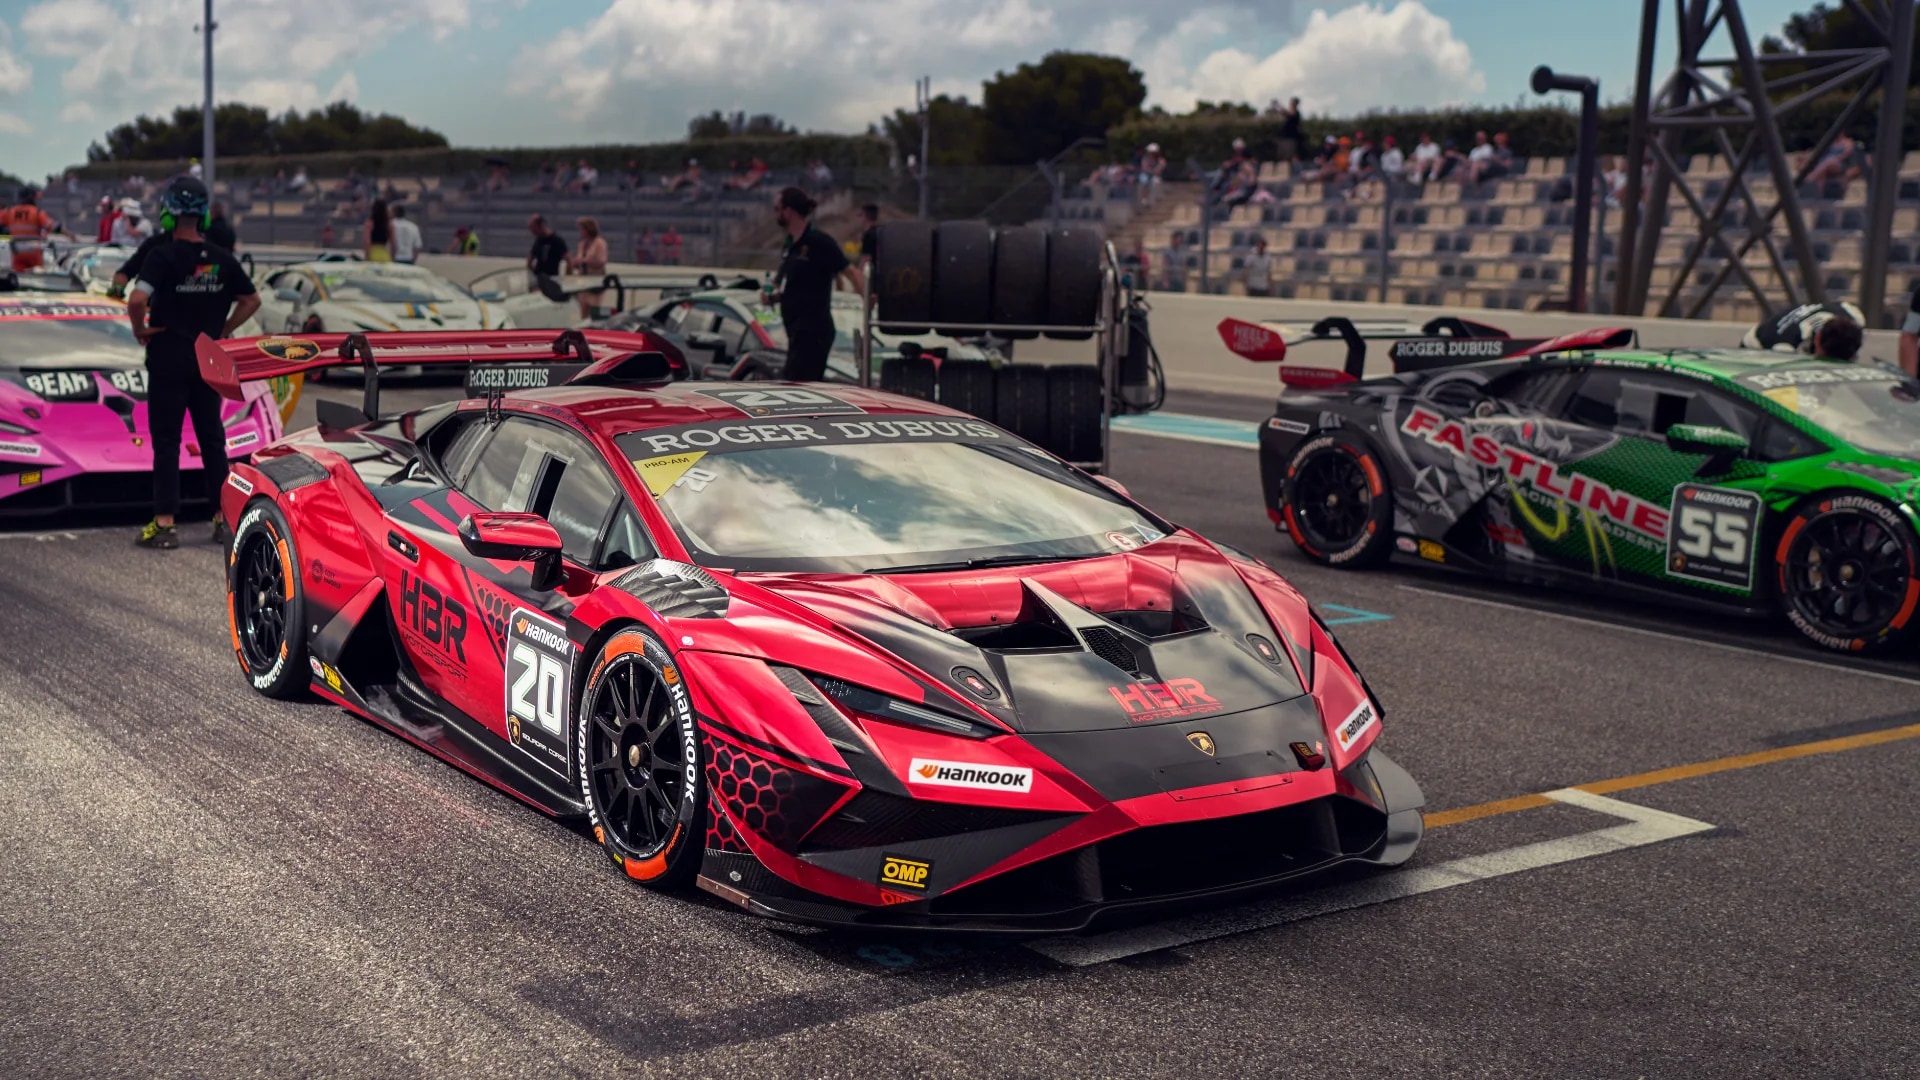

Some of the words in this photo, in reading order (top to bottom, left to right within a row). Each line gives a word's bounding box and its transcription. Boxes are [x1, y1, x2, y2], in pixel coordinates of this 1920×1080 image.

[1396, 340, 1445, 357] ROGER
[1447, 341, 1503, 356] DUBUIS
[26, 372, 89, 396] BEAM
[469, 369, 505, 387] ROGER
[507, 368, 549, 387] DUBUIS
[718, 390, 833, 406] 20
[640, 424, 828, 453] ROGER
[829, 420, 1000, 439] DUBUIS
[644, 456, 690, 469] PRO-AM
[1402, 406, 1670, 541] FASTLINE
[1677, 505, 1748, 565] 55
[401, 568, 468, 665] HBR
[402, 633, 469, 684] MOTORSPORT
[511, 643, 564, 736] 20
[1107, 677, 1220, 713] HBR
[1131, 704, 1224, 723] MOTORSPORT
[883, 862, 928, 883] OMP
